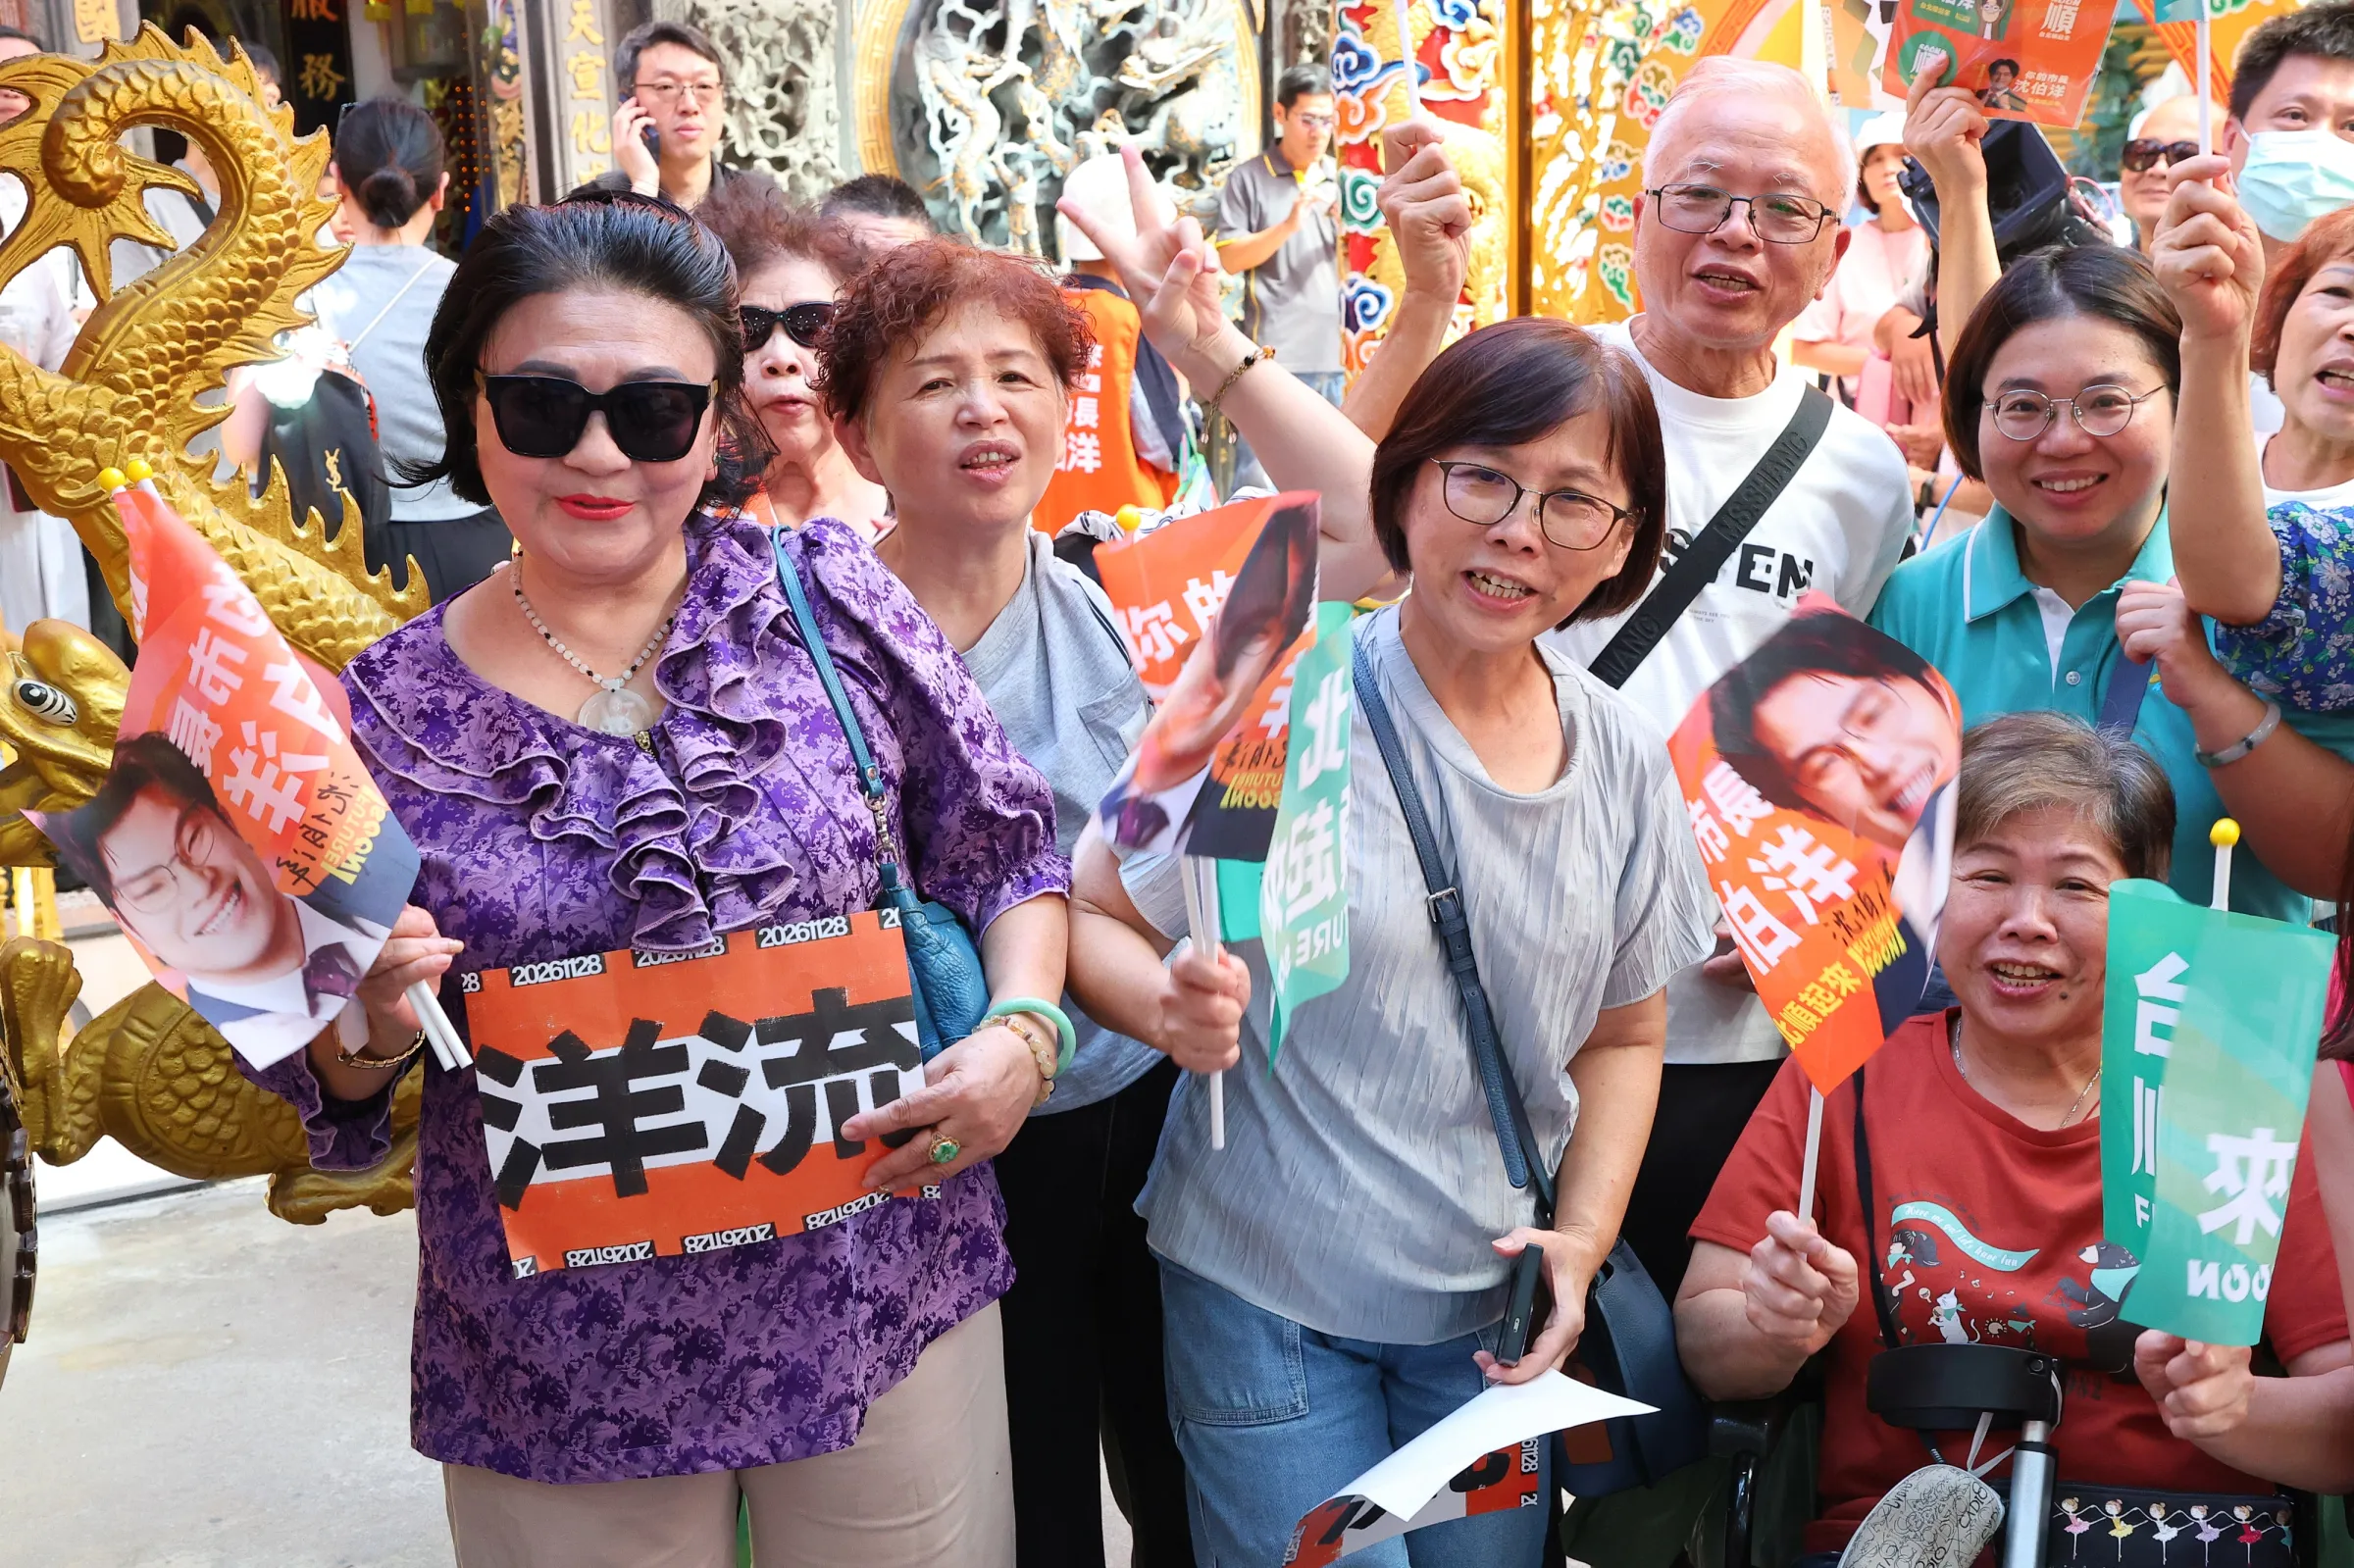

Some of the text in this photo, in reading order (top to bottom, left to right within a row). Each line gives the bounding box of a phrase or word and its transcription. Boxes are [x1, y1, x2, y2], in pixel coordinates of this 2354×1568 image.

[2040, 2, 2078, 34] 順
[2013, 78, 2066, 97] 沈伯洋
[758, 916, 848, 948] 20261128
[511, 954, 603, 986] 20261128
[476, 987, 922, 1211] 洋流
[566, 1240, 654, 1268] 20261128
[684, 1222, 774, 1254] 20261128
